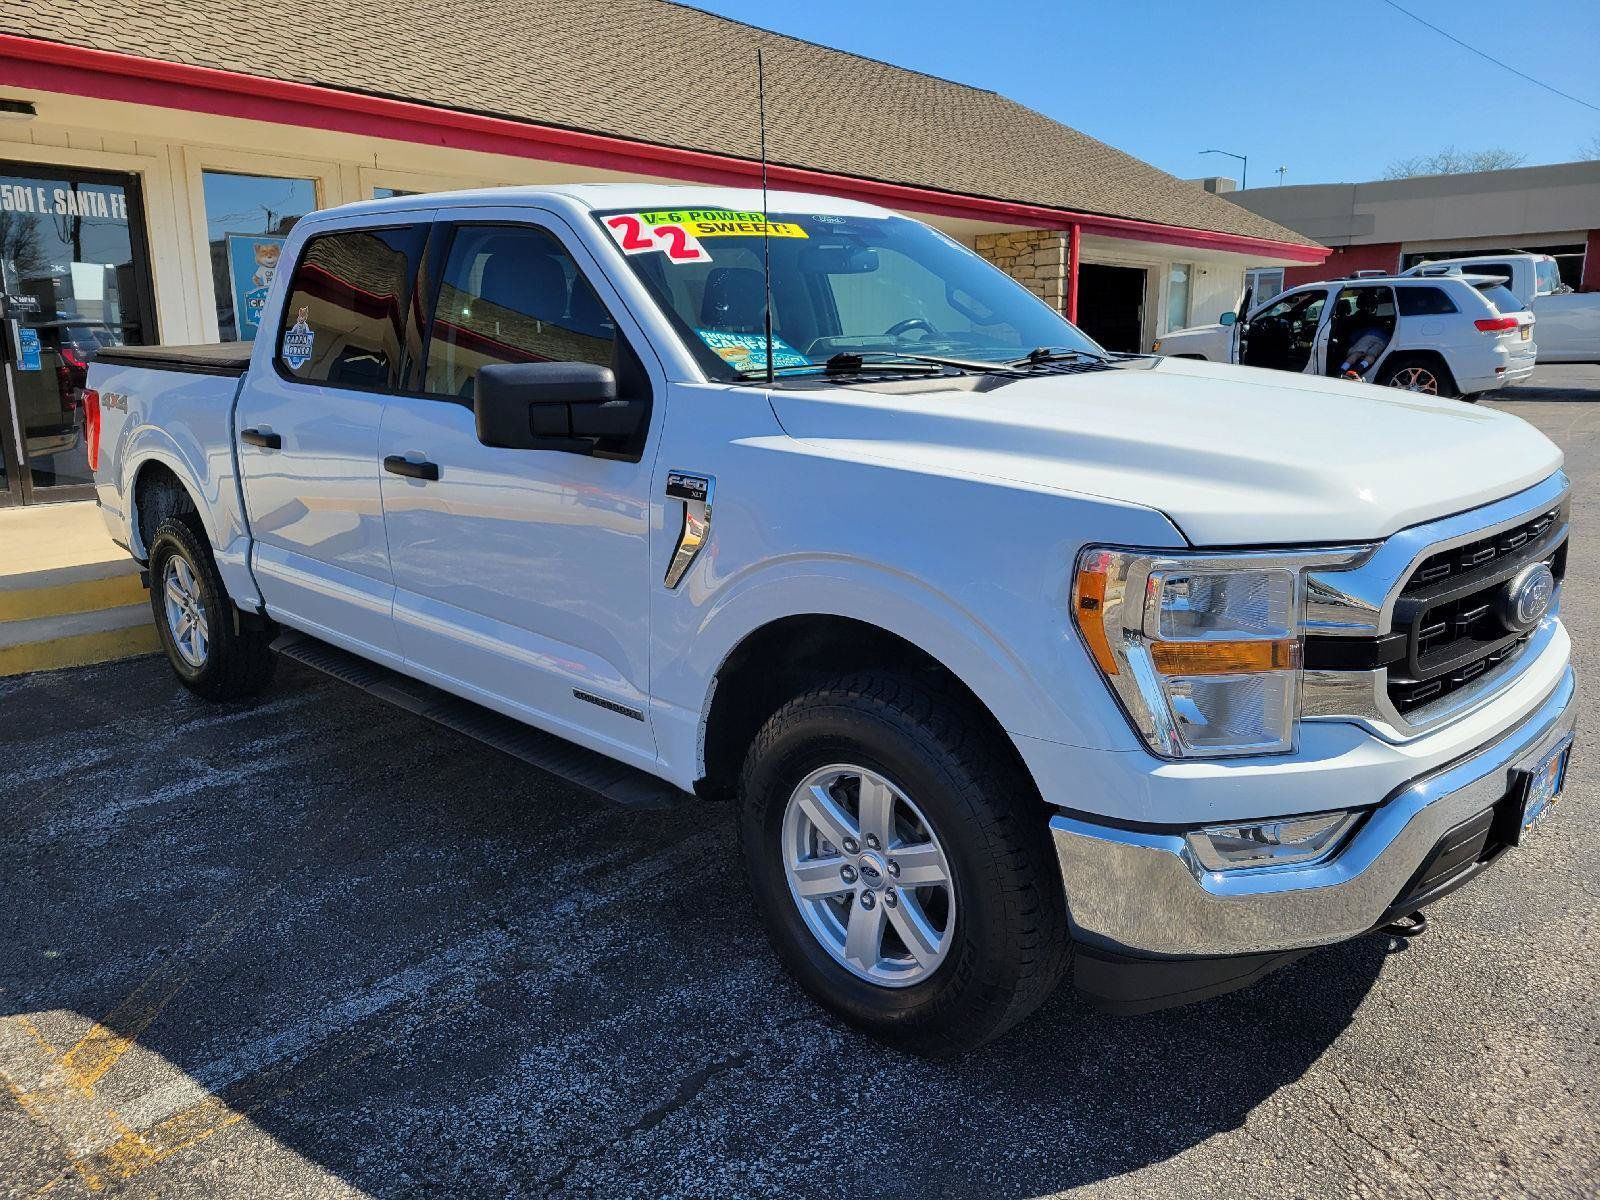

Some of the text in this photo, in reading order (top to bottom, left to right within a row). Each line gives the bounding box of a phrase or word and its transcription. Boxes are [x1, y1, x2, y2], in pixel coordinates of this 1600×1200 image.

[0, 184, 35, 212] 501
[54, 189, 109, 217] SANTA
[110, 193, 127, 219] FE
[642, 212, 763, 224] V-6 POWER
[696, 223, 792, 233] SWEET!
[669, 475, 707, 491] F-150
